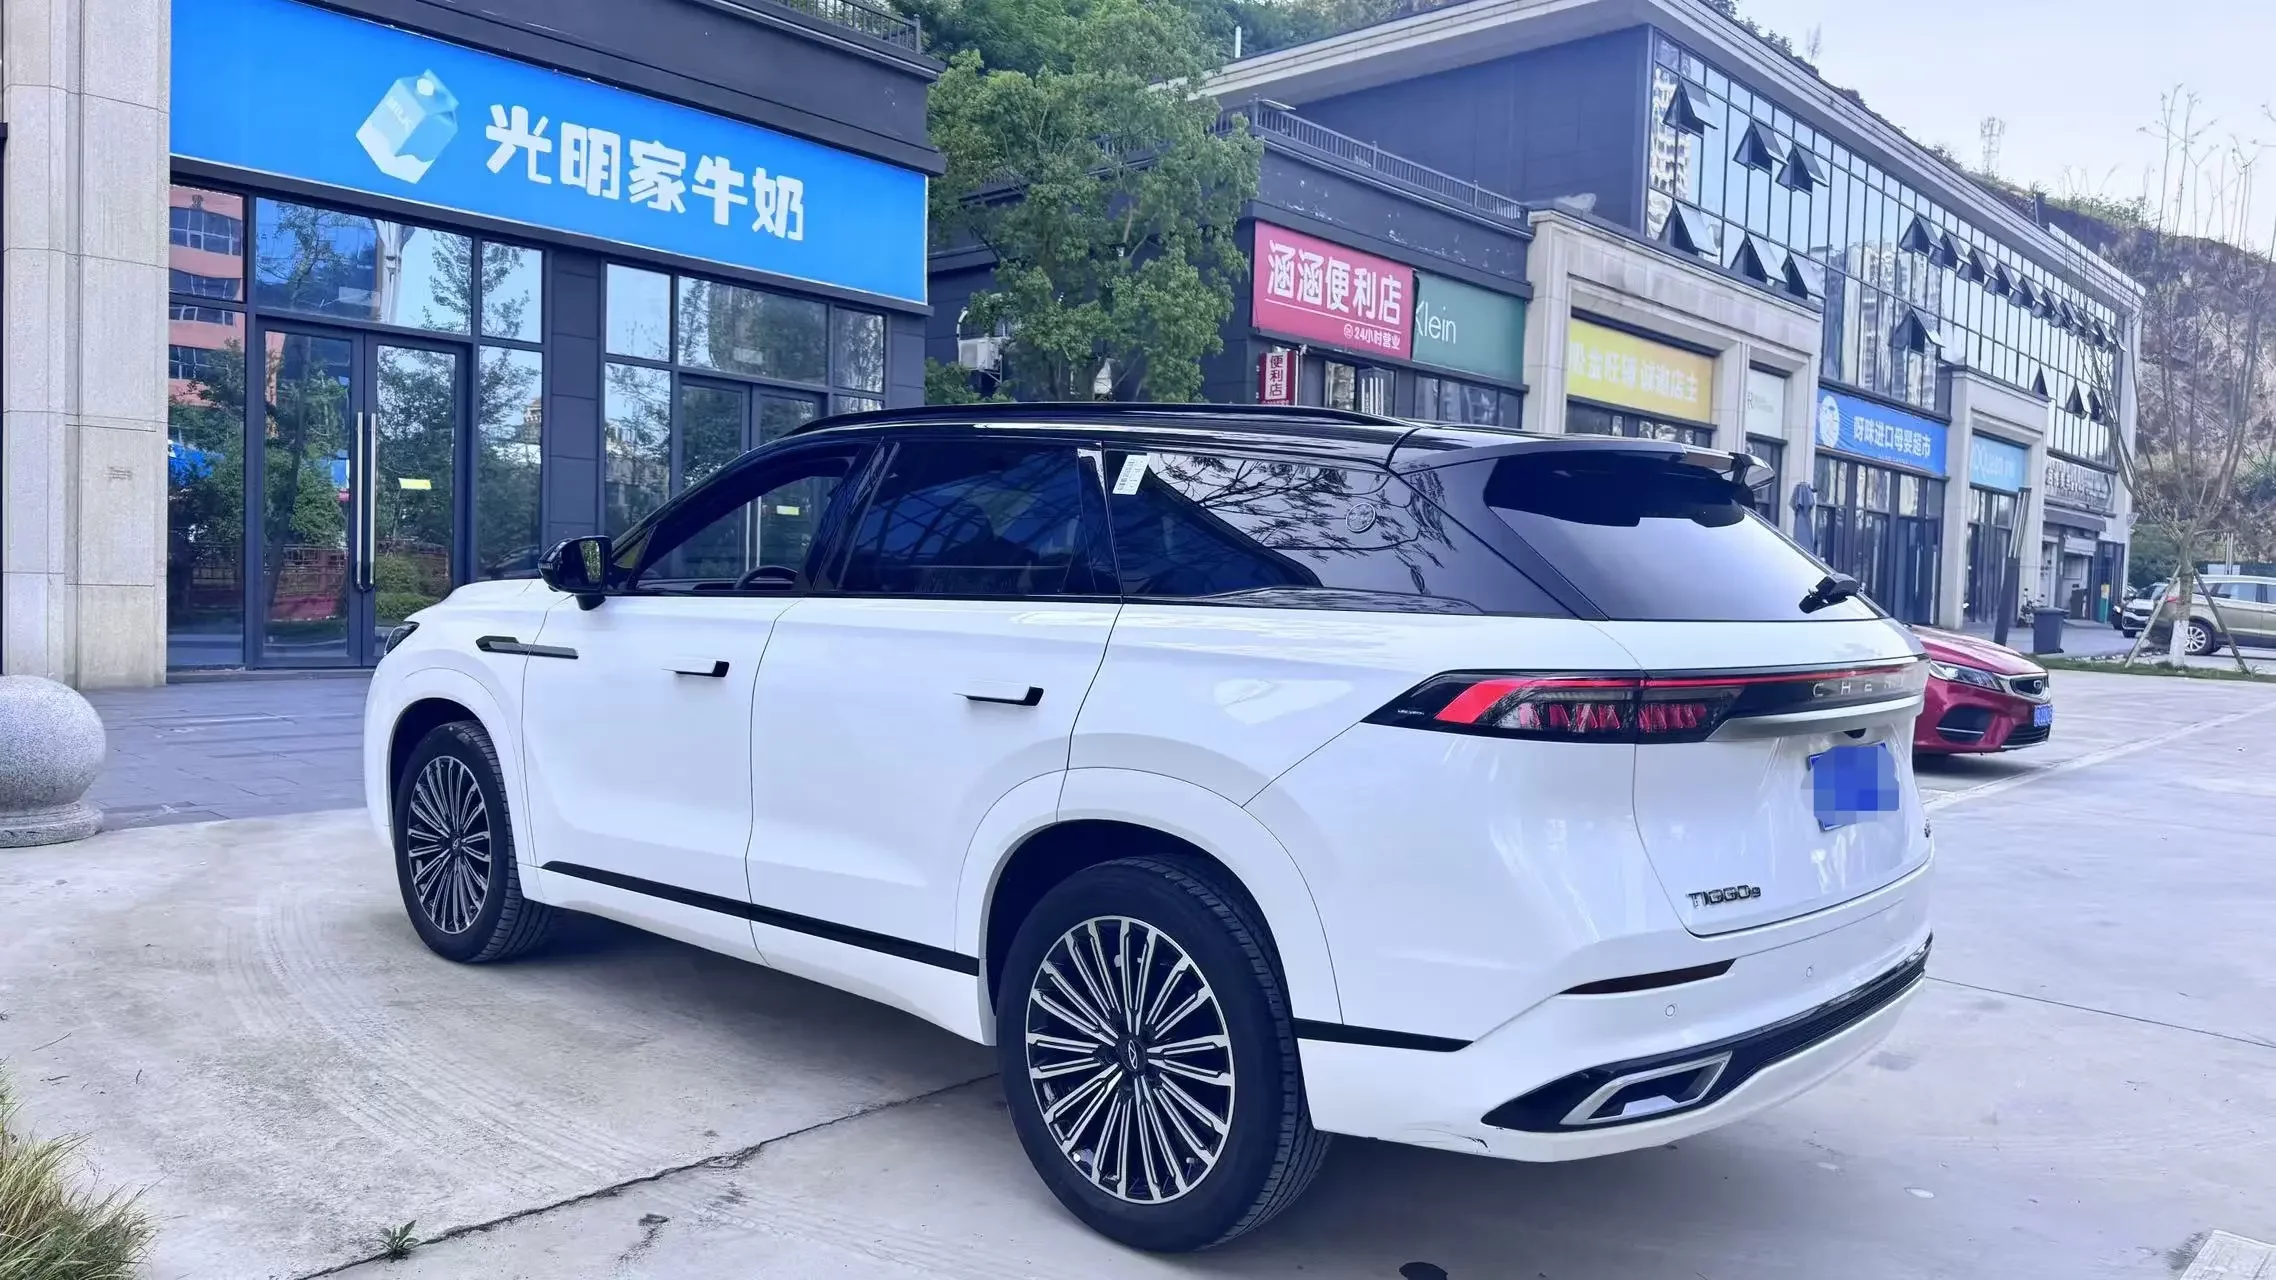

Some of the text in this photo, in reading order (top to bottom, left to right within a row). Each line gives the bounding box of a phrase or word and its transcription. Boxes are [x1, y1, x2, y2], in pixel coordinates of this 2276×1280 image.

[485, 103, 805, 241] 光明家牛奶
[1267, 240, 1402, 325] 涵涵便利店
[1354, 326, 1401, 351] 24小时营业
[1270, 355, 1284, 397] 便利店
